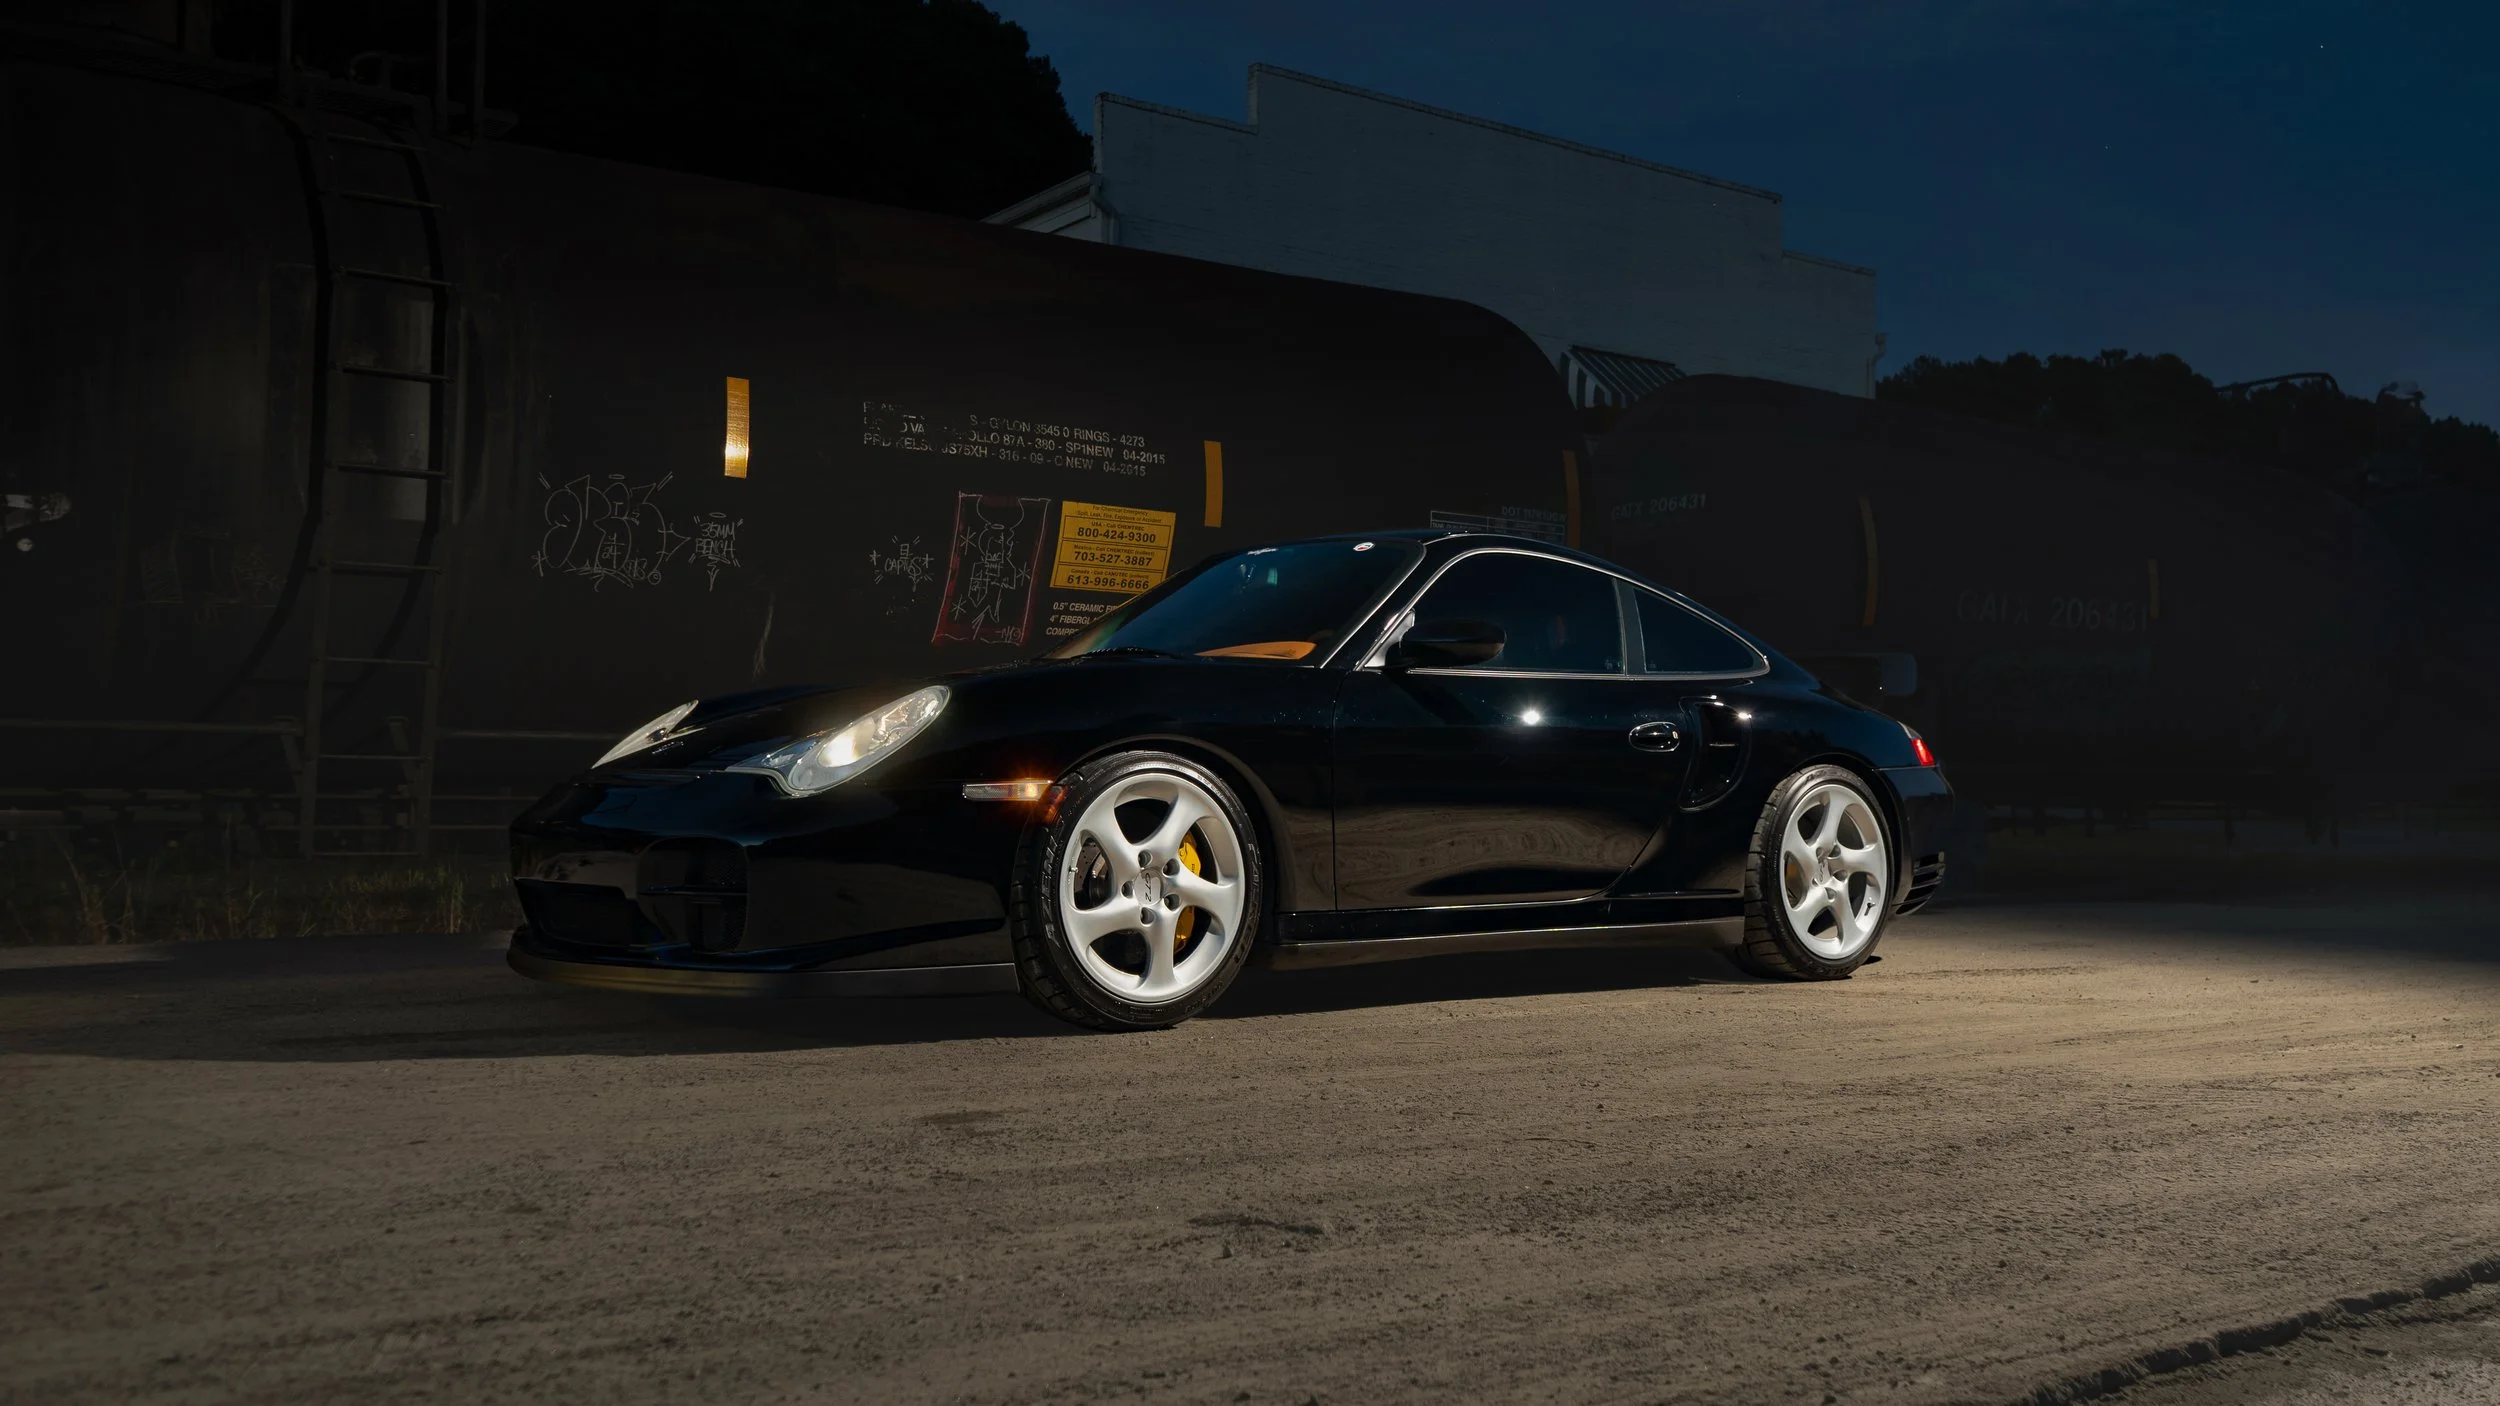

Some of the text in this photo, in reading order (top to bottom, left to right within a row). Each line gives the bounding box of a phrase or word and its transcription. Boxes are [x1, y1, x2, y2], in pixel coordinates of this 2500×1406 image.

[1074, 428, 1110, 443] RINGS
[1120, 434, 1145, 448] 4273
[1003, 434, 1025, 447] 87A
[1123, 450, 1166, 465] 04-2015
[1000, 449, 1020, 462] 316
[1065, 456, 1094, 470] NEW
[1103, 461, 1146, 477] 04-2015
[1649, 492, 1706, 513] 206431
[1078, 527, 1156, 543] 800-424-9300
[1074, 551, 1152, 567] 703-527-3887
[1067, 575, 1149, 590] 613-996-6666
[1069, 603, 1104, 613] CERAMIC
[2047, 596, 2149, 632] 206431
